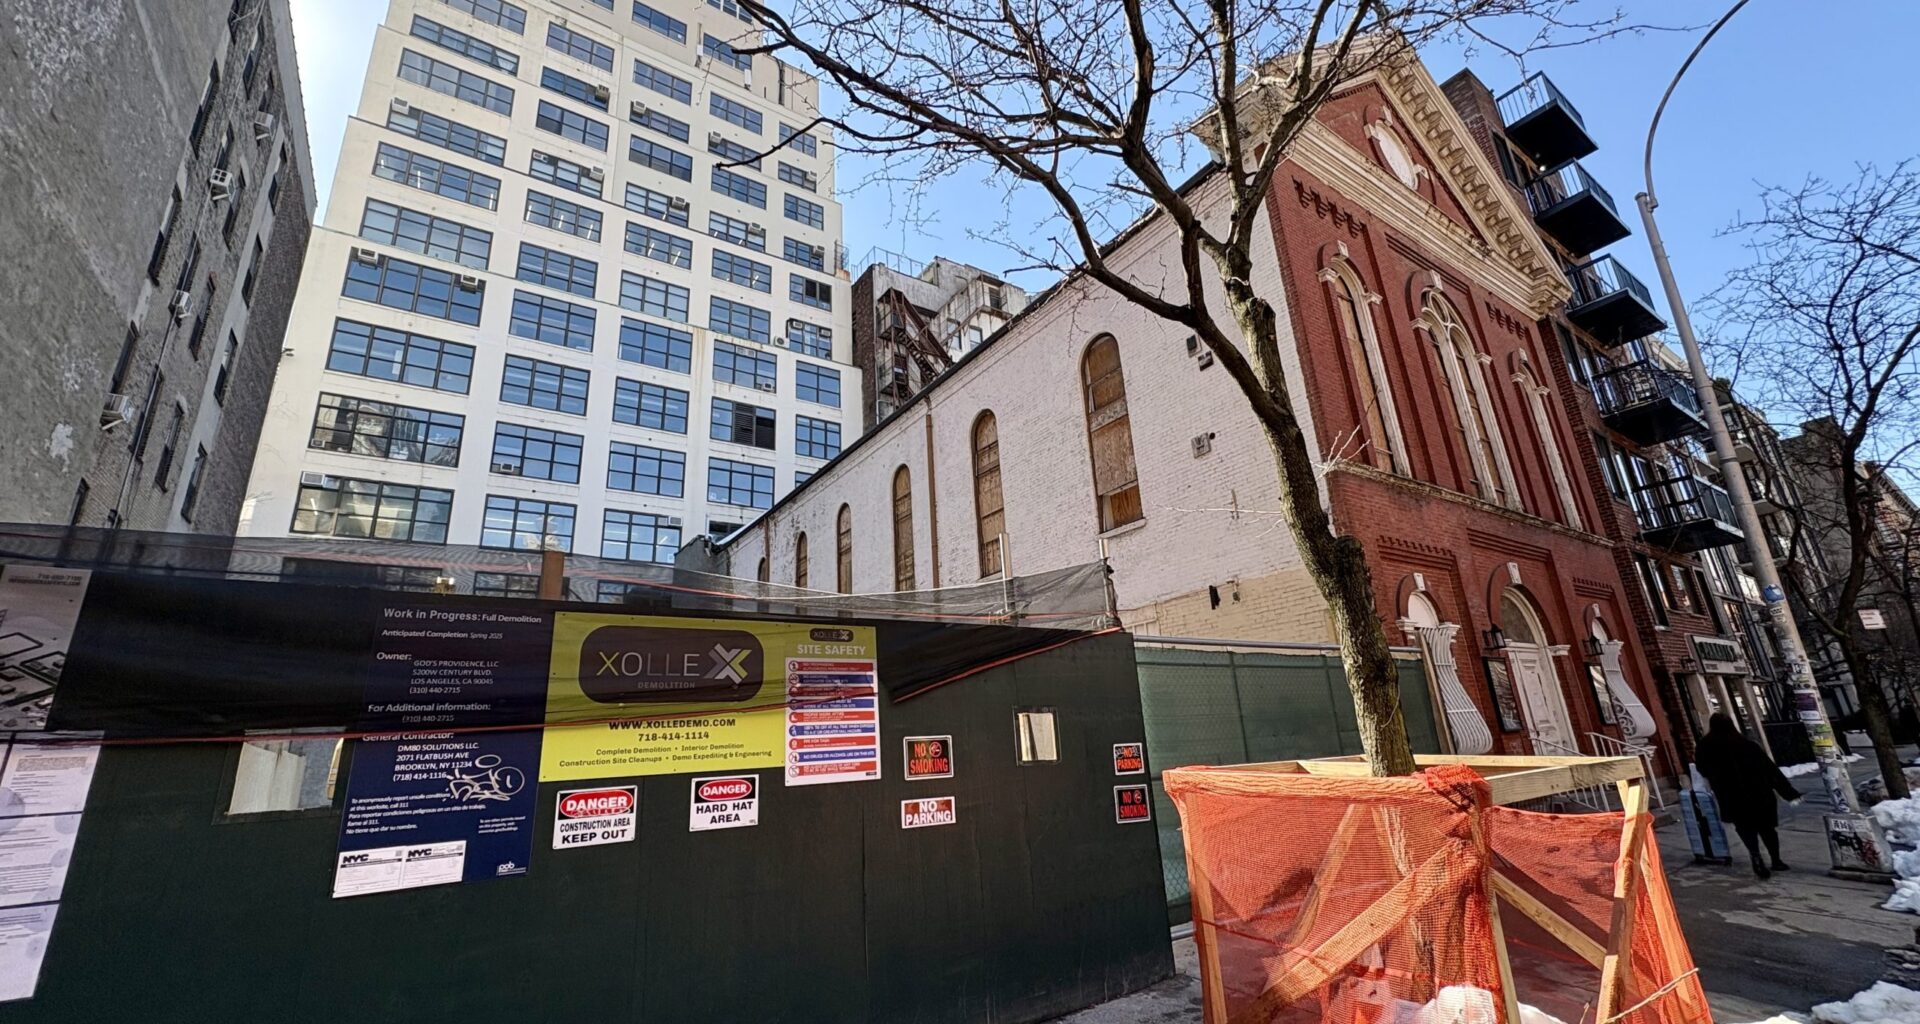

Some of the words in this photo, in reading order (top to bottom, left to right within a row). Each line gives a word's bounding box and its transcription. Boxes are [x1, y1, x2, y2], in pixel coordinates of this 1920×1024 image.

[384, 608, 413, 618] Work
[416, 610, 426, 619] in
[430, 610, 481, 622] Progress:
[498, 615, 542, 623] Demolition
[426, 631, 468, 639] Completion
[798, 644, 822, 654] SITE
[825, 645, 866, 655] SAFETY
[376, 652, 412, 660] Owner:
[368, 704, 384, 712] For
[385, 703, 435, 712] Additional
[609, 719, 736, 730] WWW.XOLLEDEMO.COM
[638, 731, 709, 741] 718-414-1114
[422, 743, 465, 751] SOLUTIONS
[596, 748, 632, 756] Complete
[633, 746, 672, 754] Demolition
[914, 743, 926, 758] NO
[1123, 747, 1132, 757] NO
[396, 754, 414, 762] 2071
[416, 753, 454, 761] FLATBUSH
[454, 752, 469, 760] AVE
[560, 759, 611, 767] Construction
[628, 756, 662, 764] Cleanups
[694, 752, 728, 760] Expediting
[394, 763, 438, 772] BROOKLYN,
[910, 758, 948, 774] SMOKING
[1117, 758, 1142, 770] PARKING
[392, 773, 412, 782] (718)
[703, 784, 747, 796] DANGER
[1122, 791, 1132, 804] NO
[566, 796, 627, 811] DANGER
[696, 804, 727, 814] HARD
[733, 801, 753, 811] HAT
[919, 801, 937, 812] NO
[1120, 805, 1146, 817] SMOKING
[710, 813, 741, 824] AREA
[906, 810, 951, 826] PARKING
[560, 820, 611, 832] CONSTRUCTION
[613, 818, 630, 827] AREA
[562, 832, 597, 844] KEEP
[601, 829, 627, 840] OUT
[343, 854, 369, 864] NYC
[408, 849, 432, 858] NYC
